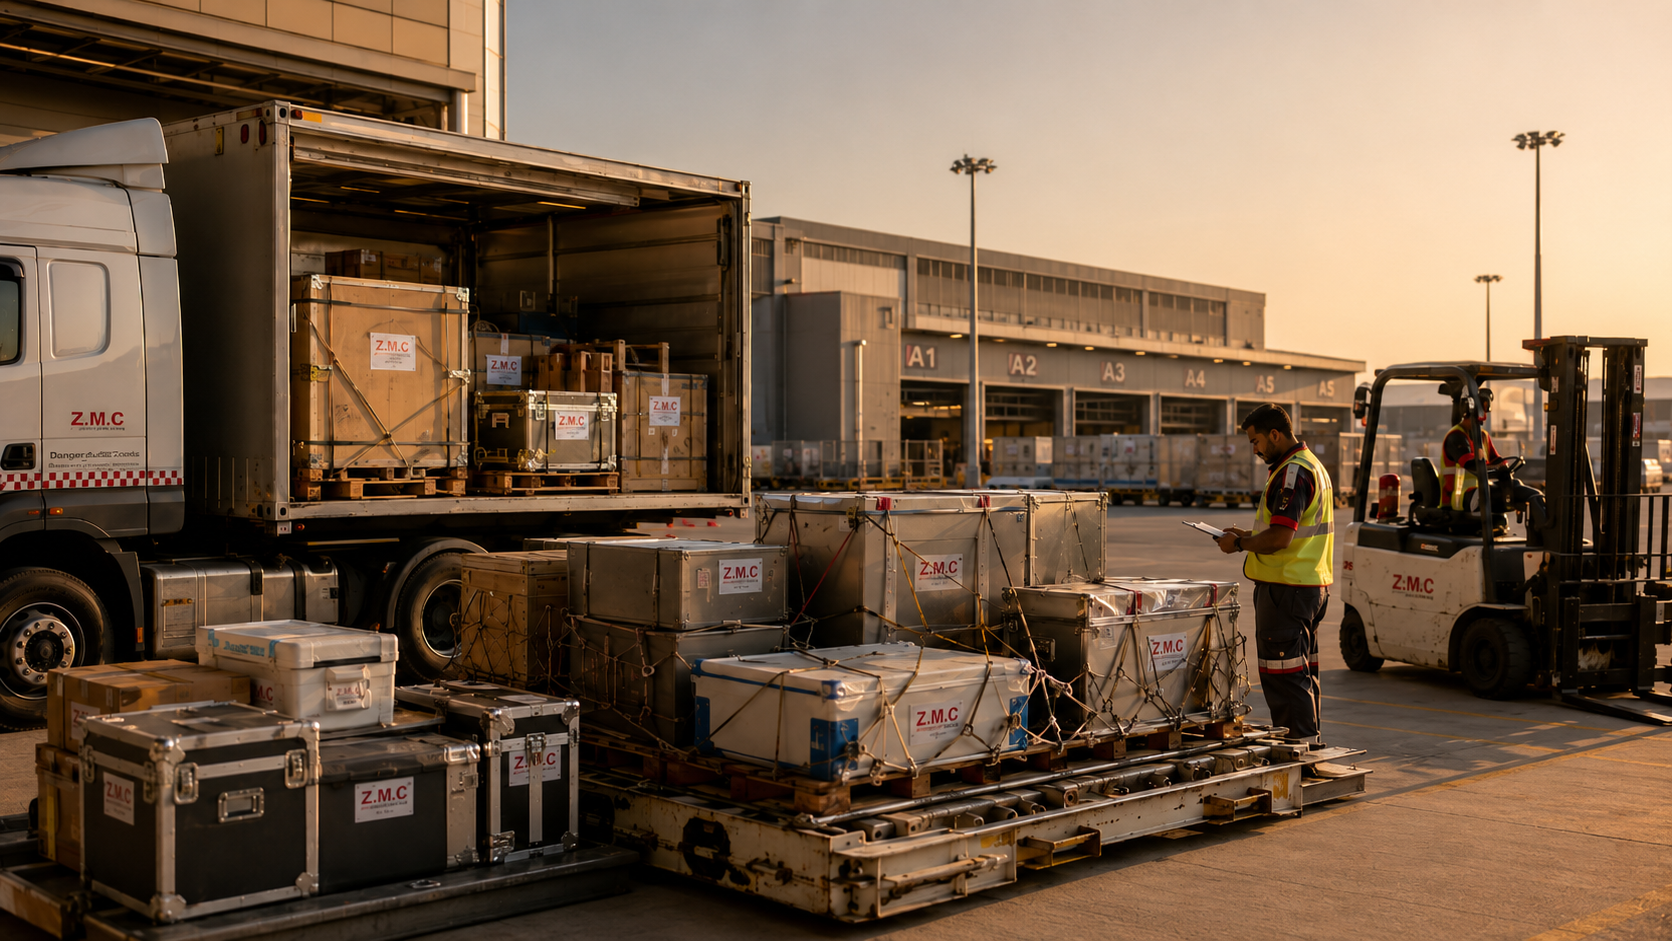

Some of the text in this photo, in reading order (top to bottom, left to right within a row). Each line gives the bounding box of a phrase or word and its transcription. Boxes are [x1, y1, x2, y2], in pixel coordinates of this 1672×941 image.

[376, 340, 409, 352] Z.M.C
[908, 345, 935, 368] A1
[491, 360, 517, 371] Z.M.C
[1010, 354, 1037, 376] A2
[1102, 361, 1126, 382] A3
[1184, 369, 1206, 388] A4
[653, 401, 677, 411] Z.M.C
[71, 411, 124, 426] Z.M.C
[558, 416, 585, 426] Z.M.C
[723, 565, 758, 579] Z.M.C
[919, 560, 958, 575] Z.M.C
[1152, 639, 1183, 655] Z.M.C
[916, 707, 958, 726] Z.M.C
[361, 785, 408, 805] Z.M.C
